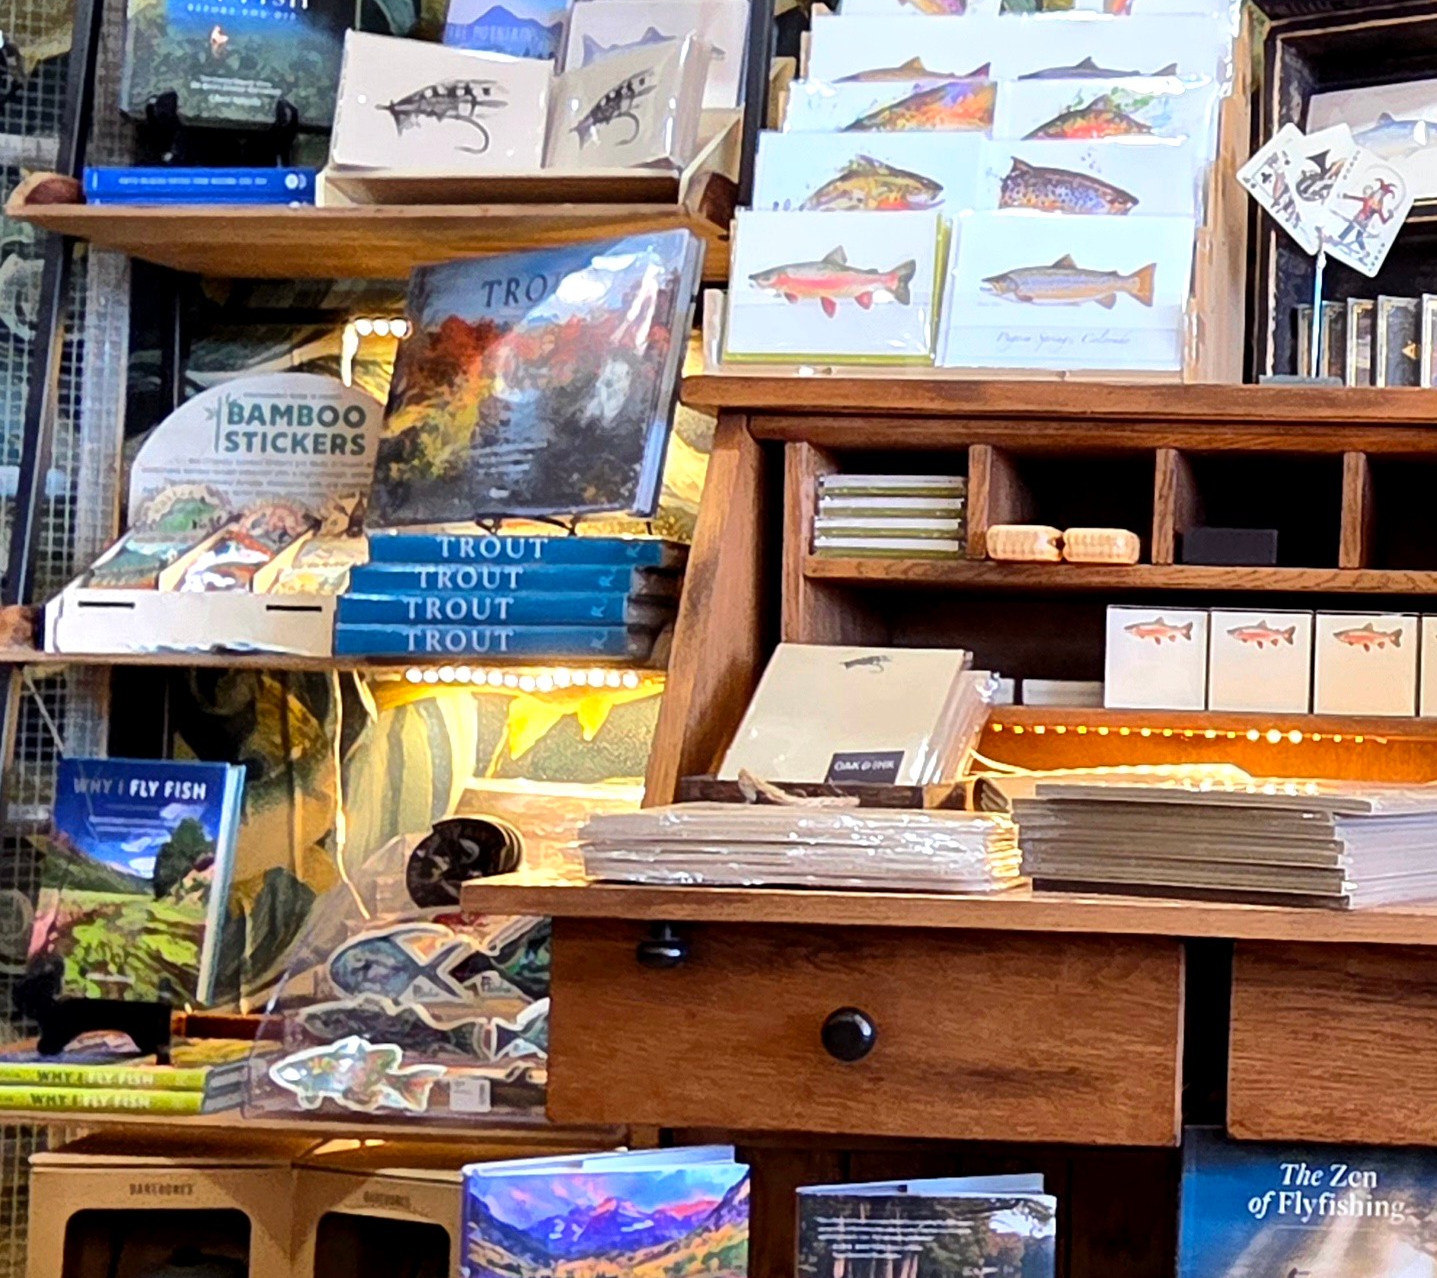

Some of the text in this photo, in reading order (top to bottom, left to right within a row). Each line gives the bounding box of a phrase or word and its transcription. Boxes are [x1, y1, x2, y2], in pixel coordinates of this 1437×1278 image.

[481, 273, 556, 308] TRO
[227, 400, 368, 429] BAMBOO
[223, 430, 367, 457] STICKERS
[435, 536, 549, 560] TROUT
[403, 597, 514, 620] TROUT
[404, 629, 515, 653] TROUT
[73, 778, 206, 800] WHY I FLY FISH
[1279, 1162, 1377, 1189] The Zen
[1248, 1190, 1405, 1223] of Flyfishing
